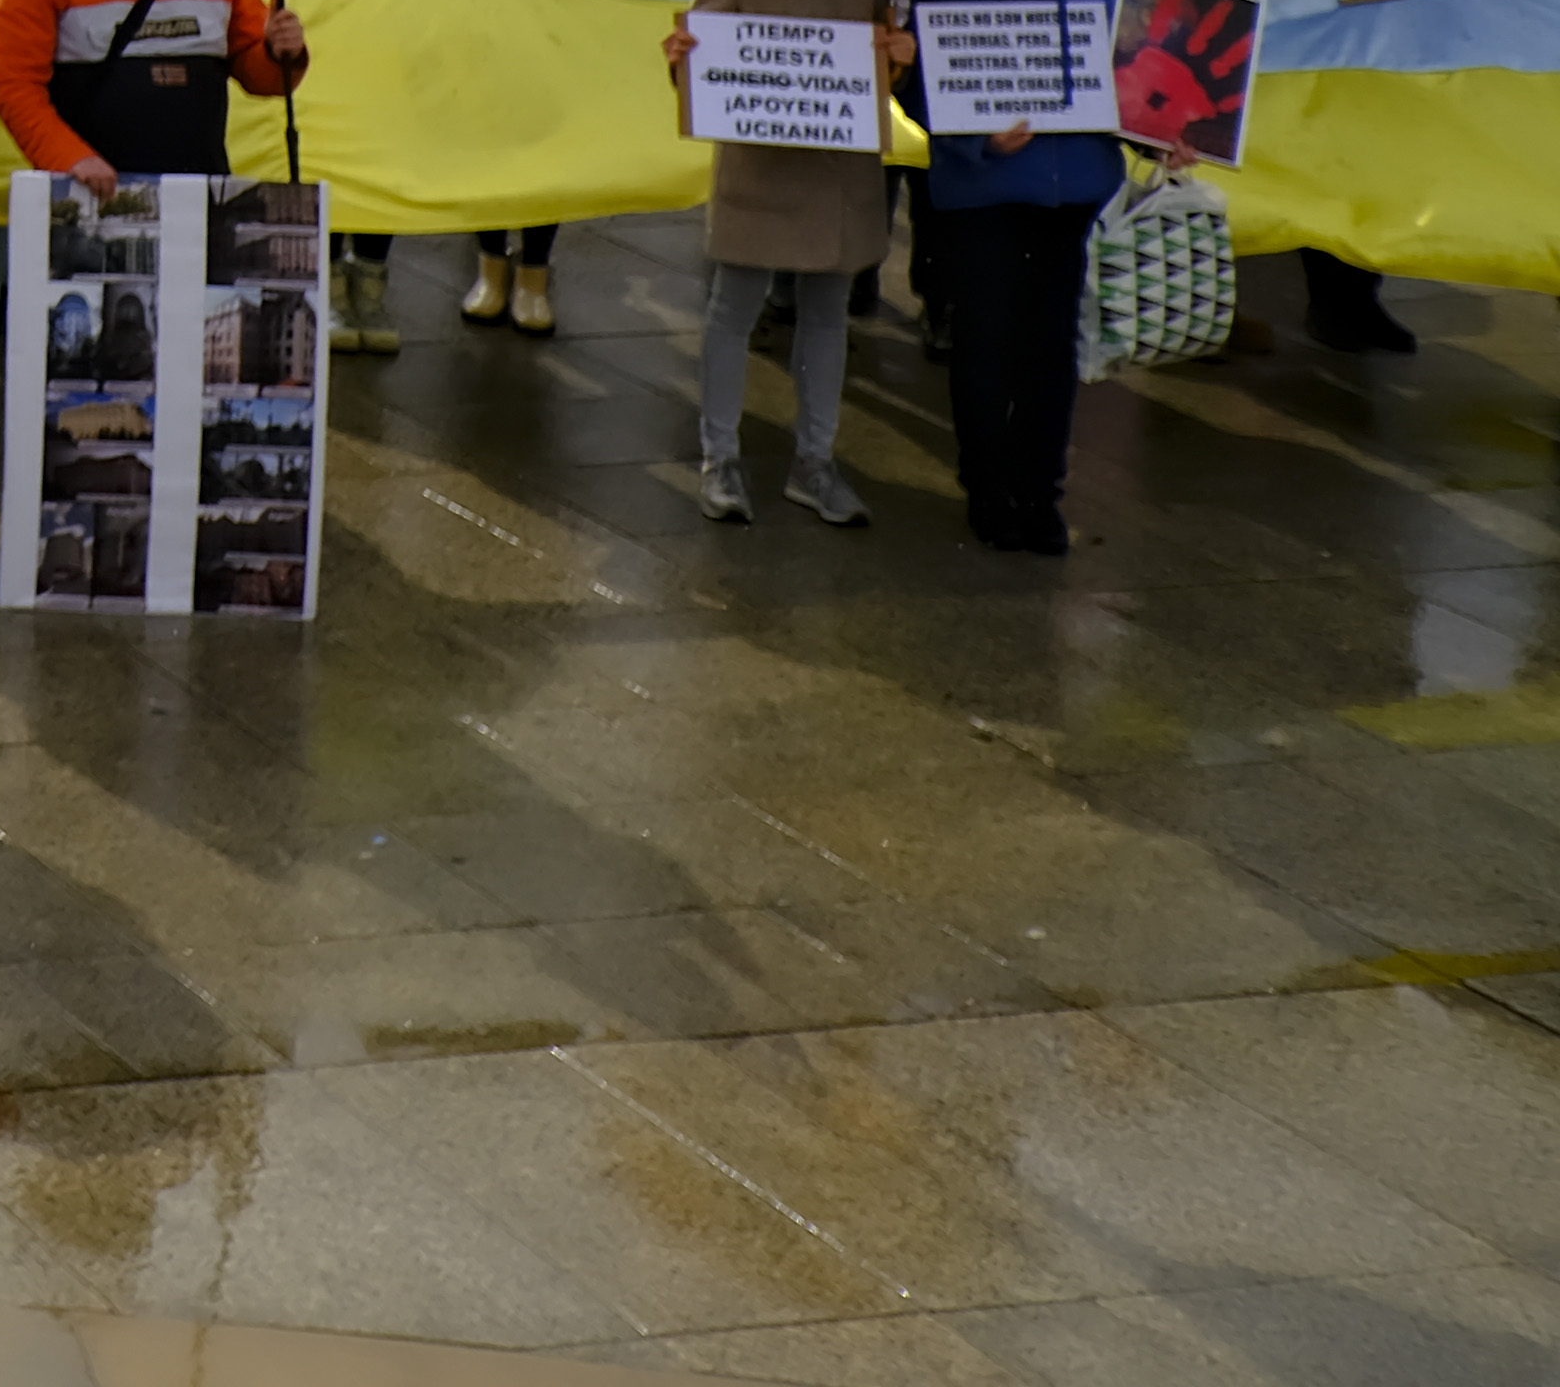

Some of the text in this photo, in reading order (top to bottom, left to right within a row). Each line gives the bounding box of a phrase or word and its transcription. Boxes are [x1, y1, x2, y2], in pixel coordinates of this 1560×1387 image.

[928, 10, 1097, 26] ESTAS NO SON NUESRAS
[736, 22, 835, 44] ¡TIEMPO
[739, 45, 835, 69] CUESTA
[797, 74, 871, 96] VIDAS!
[938, 79, 983, 95] PASAR
[986, 78, 1014, 93] CON
[725, 94, 855, 120] ¡APOYEN A
[974, 100, 991, 115] DE
[735, 120, 854, 144] UCRANIA!
